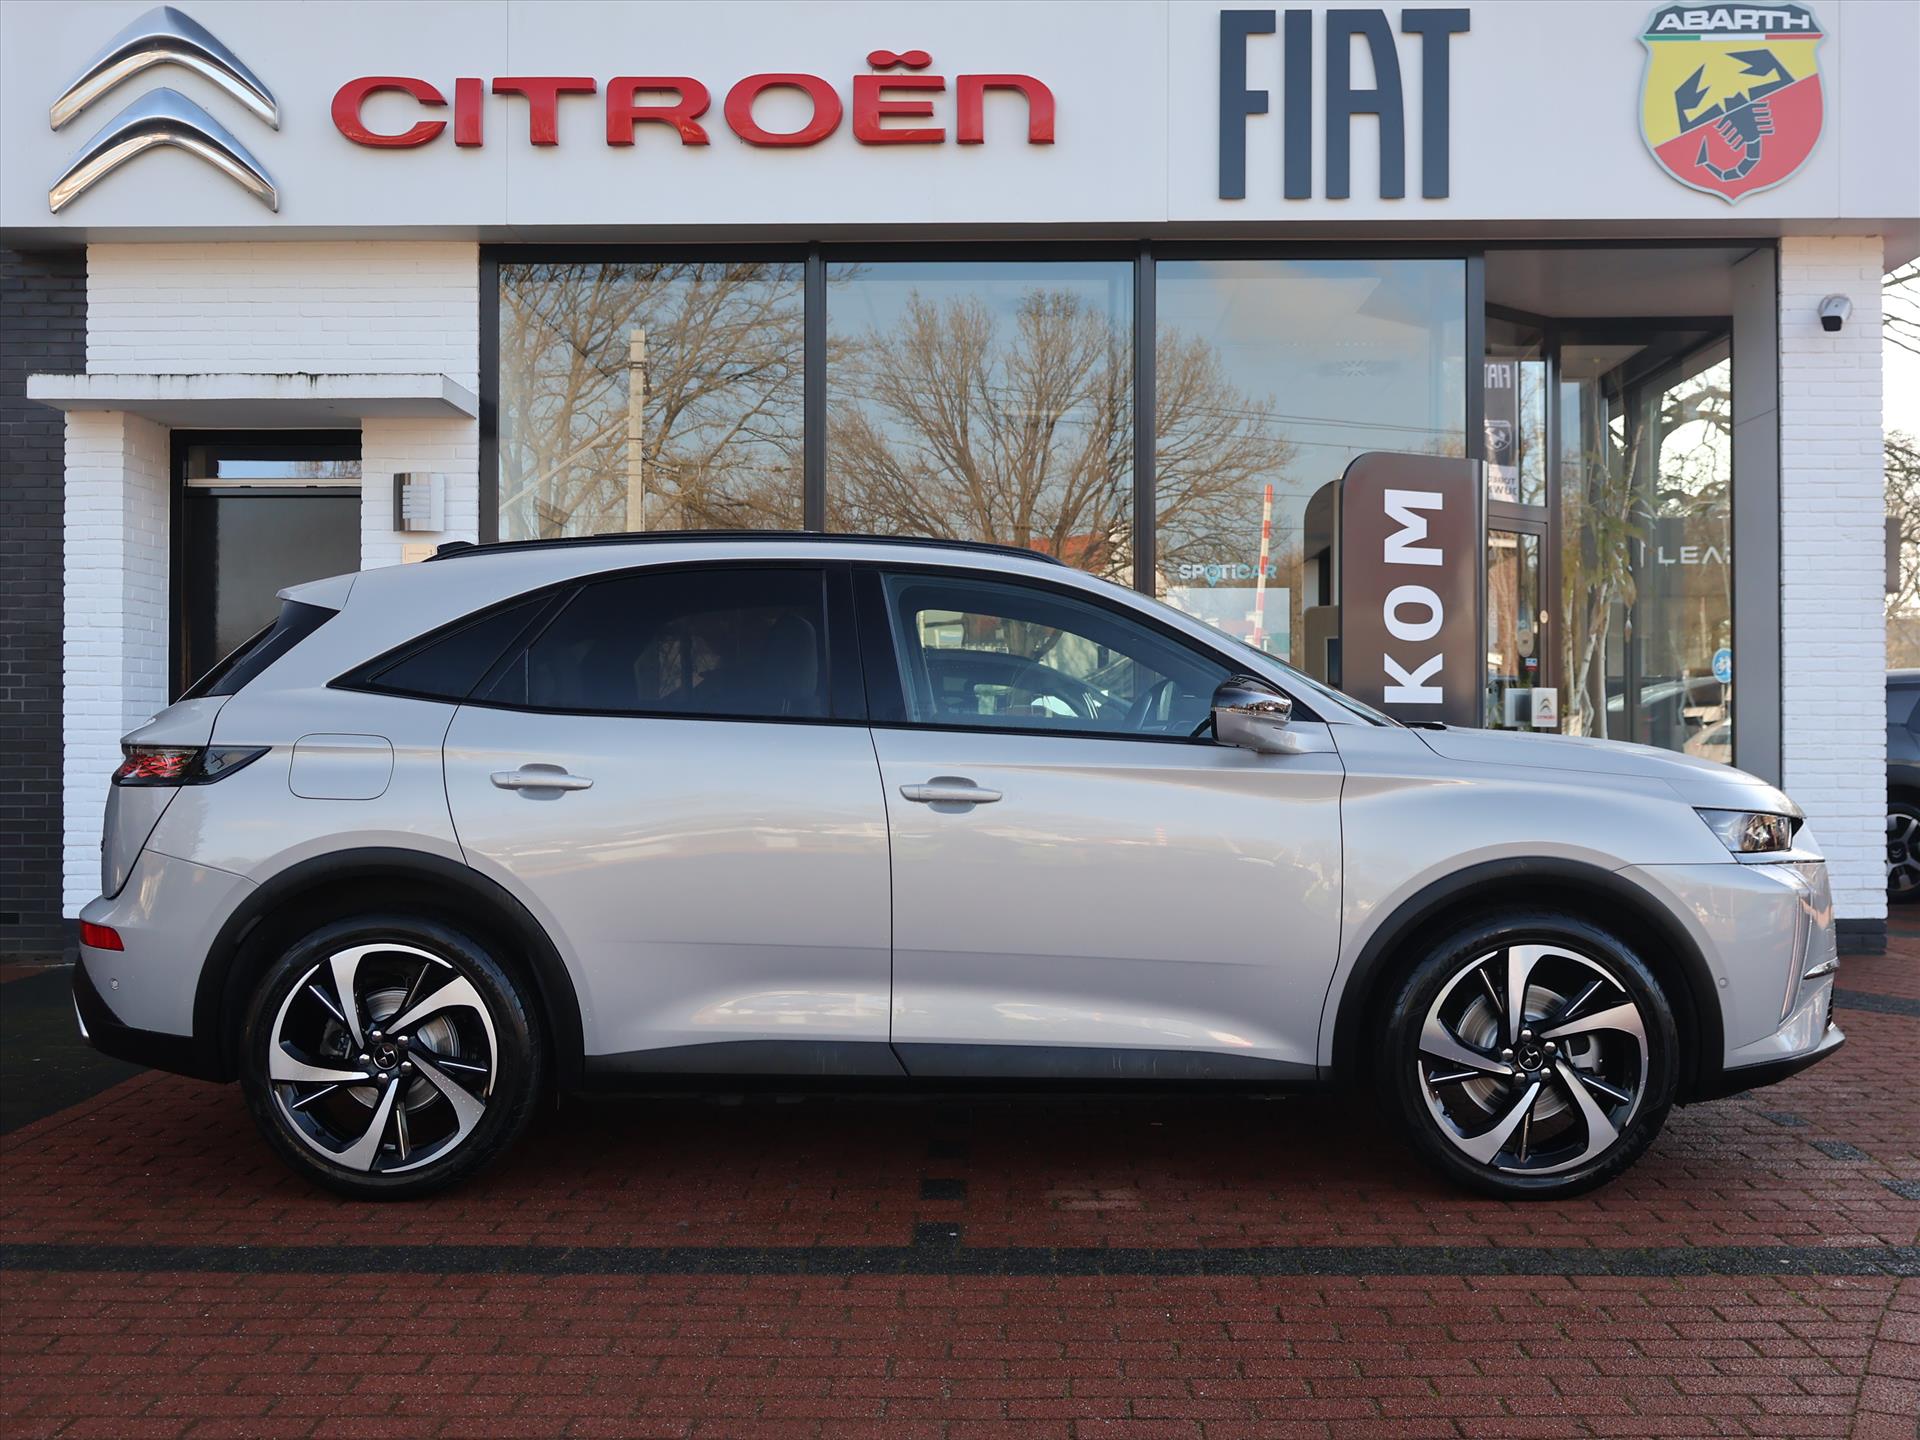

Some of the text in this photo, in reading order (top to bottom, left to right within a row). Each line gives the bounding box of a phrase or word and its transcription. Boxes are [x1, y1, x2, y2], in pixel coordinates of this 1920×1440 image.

[1655, 8, 1810, 31] ABARTH
[331, 50, 1056, 148] CITROËN
[1219, 8, 1470, 201] FIAT
[1383, 489, 1444, 706] KOM
[1657, 545, 1731, 564] LEA
